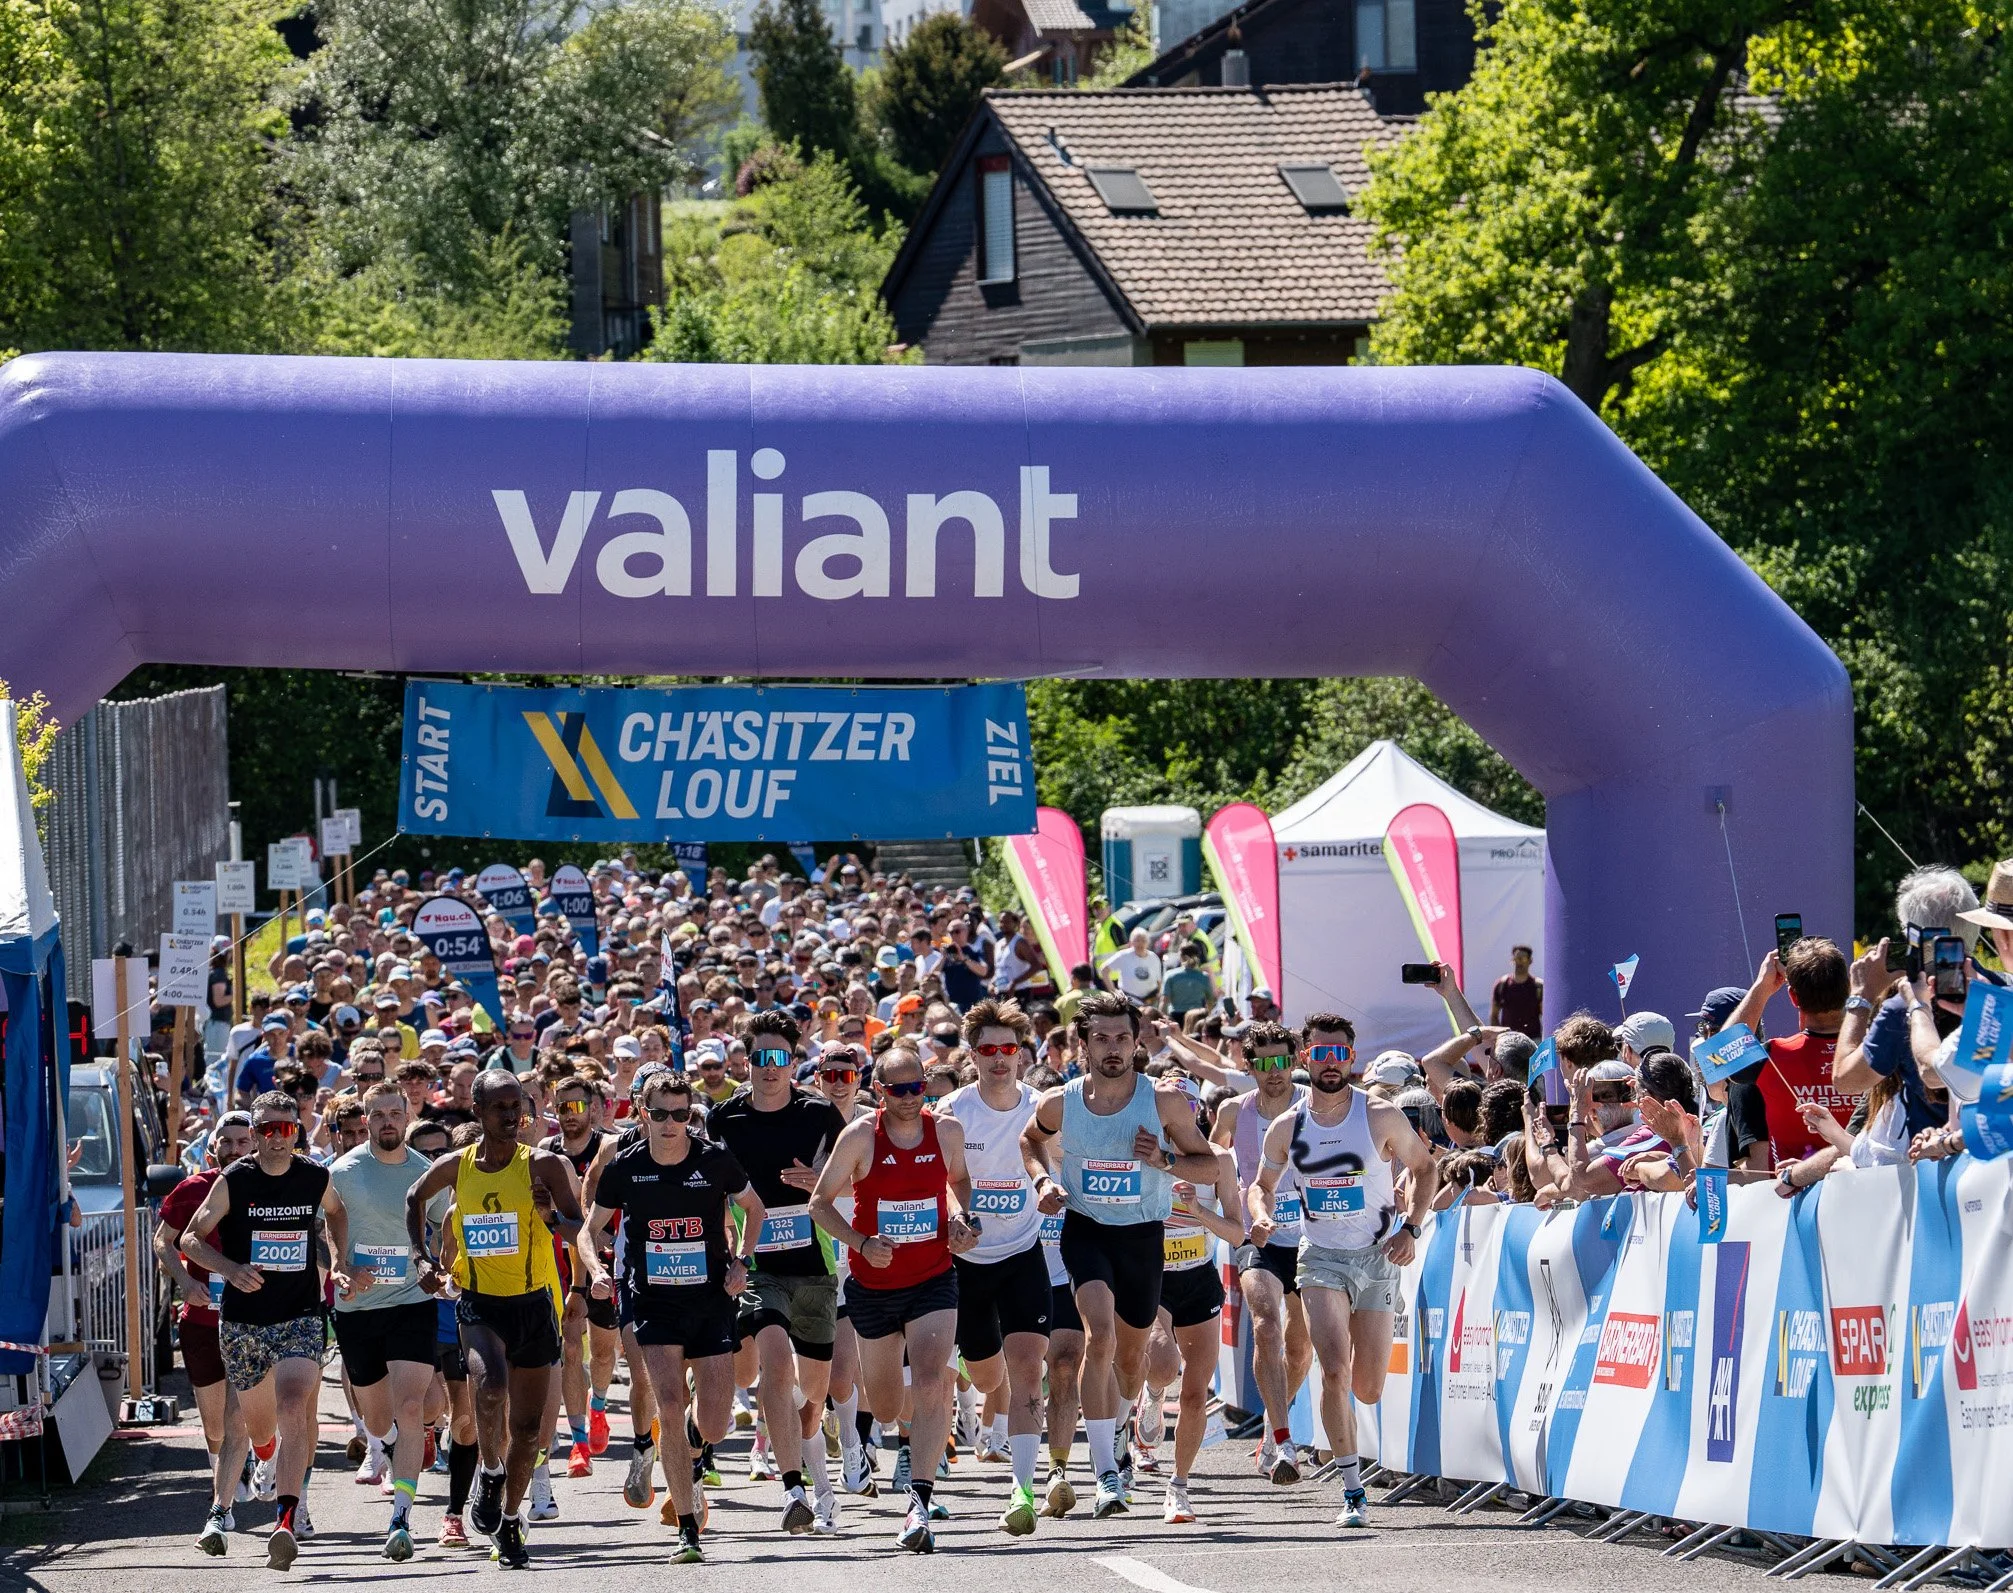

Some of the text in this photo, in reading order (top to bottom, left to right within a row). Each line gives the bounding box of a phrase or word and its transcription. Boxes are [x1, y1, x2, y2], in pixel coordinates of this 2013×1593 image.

[491, 447, 1080, 600] valiant
[618, 710, 916, 763] CHÄSITZER
[414, 696, 451, 822] START
[985, 718, 1023, 807] ZIEL
[655, 768, 797, 819] LOUF
[1300, 841, 1384, 857] samarite
[434, 912, 472, 922] Nau.ch
[1726, 1046, 1746, 1062] LOUF
[1088, 1175, 1131, 1192] 2071
[1326, 1190, 1340, 1199] 22
[892, 1201, 925, 1212] valiant
[975, 1194, 1020, 1210] 2098
[1320, 1200, 1350, 1211] JENS
[1713, 1193, 1721, 1216] LOUF
[248, 1205, 313, 1217] HORIZONTE
[902, 1212, 915, 1222] 15
[472, 1214, 505, 1224] valiant
[769, 1218, 794, 1229] 1325
[1046, 1220, 1057, 1228] 21
[648, 1217, 703, 1239] STB
[884, 1222, 931, 1234] STEFAN
[468, 1228, 509, 1245] 2001
[770, 1229, 795, 1242] JAN
[367, 1246, 397, 1256] valiant
[1171, 1240, 1183, 1249] 11
[258, 1245, 300, 1260] 2002
[1164, 1248, 1198, 1261] UDITH
[375, 1256, 387, 1265] 18
[669, 1255, 682, 1264] 17
[655, 1265, 698, 1276] JAVIER
[1839, 1317, 1887, 1365] SPAR
[1787, 1357, 1818, 1399] LOUF
[1853, 1384, 1892, 1420] express
